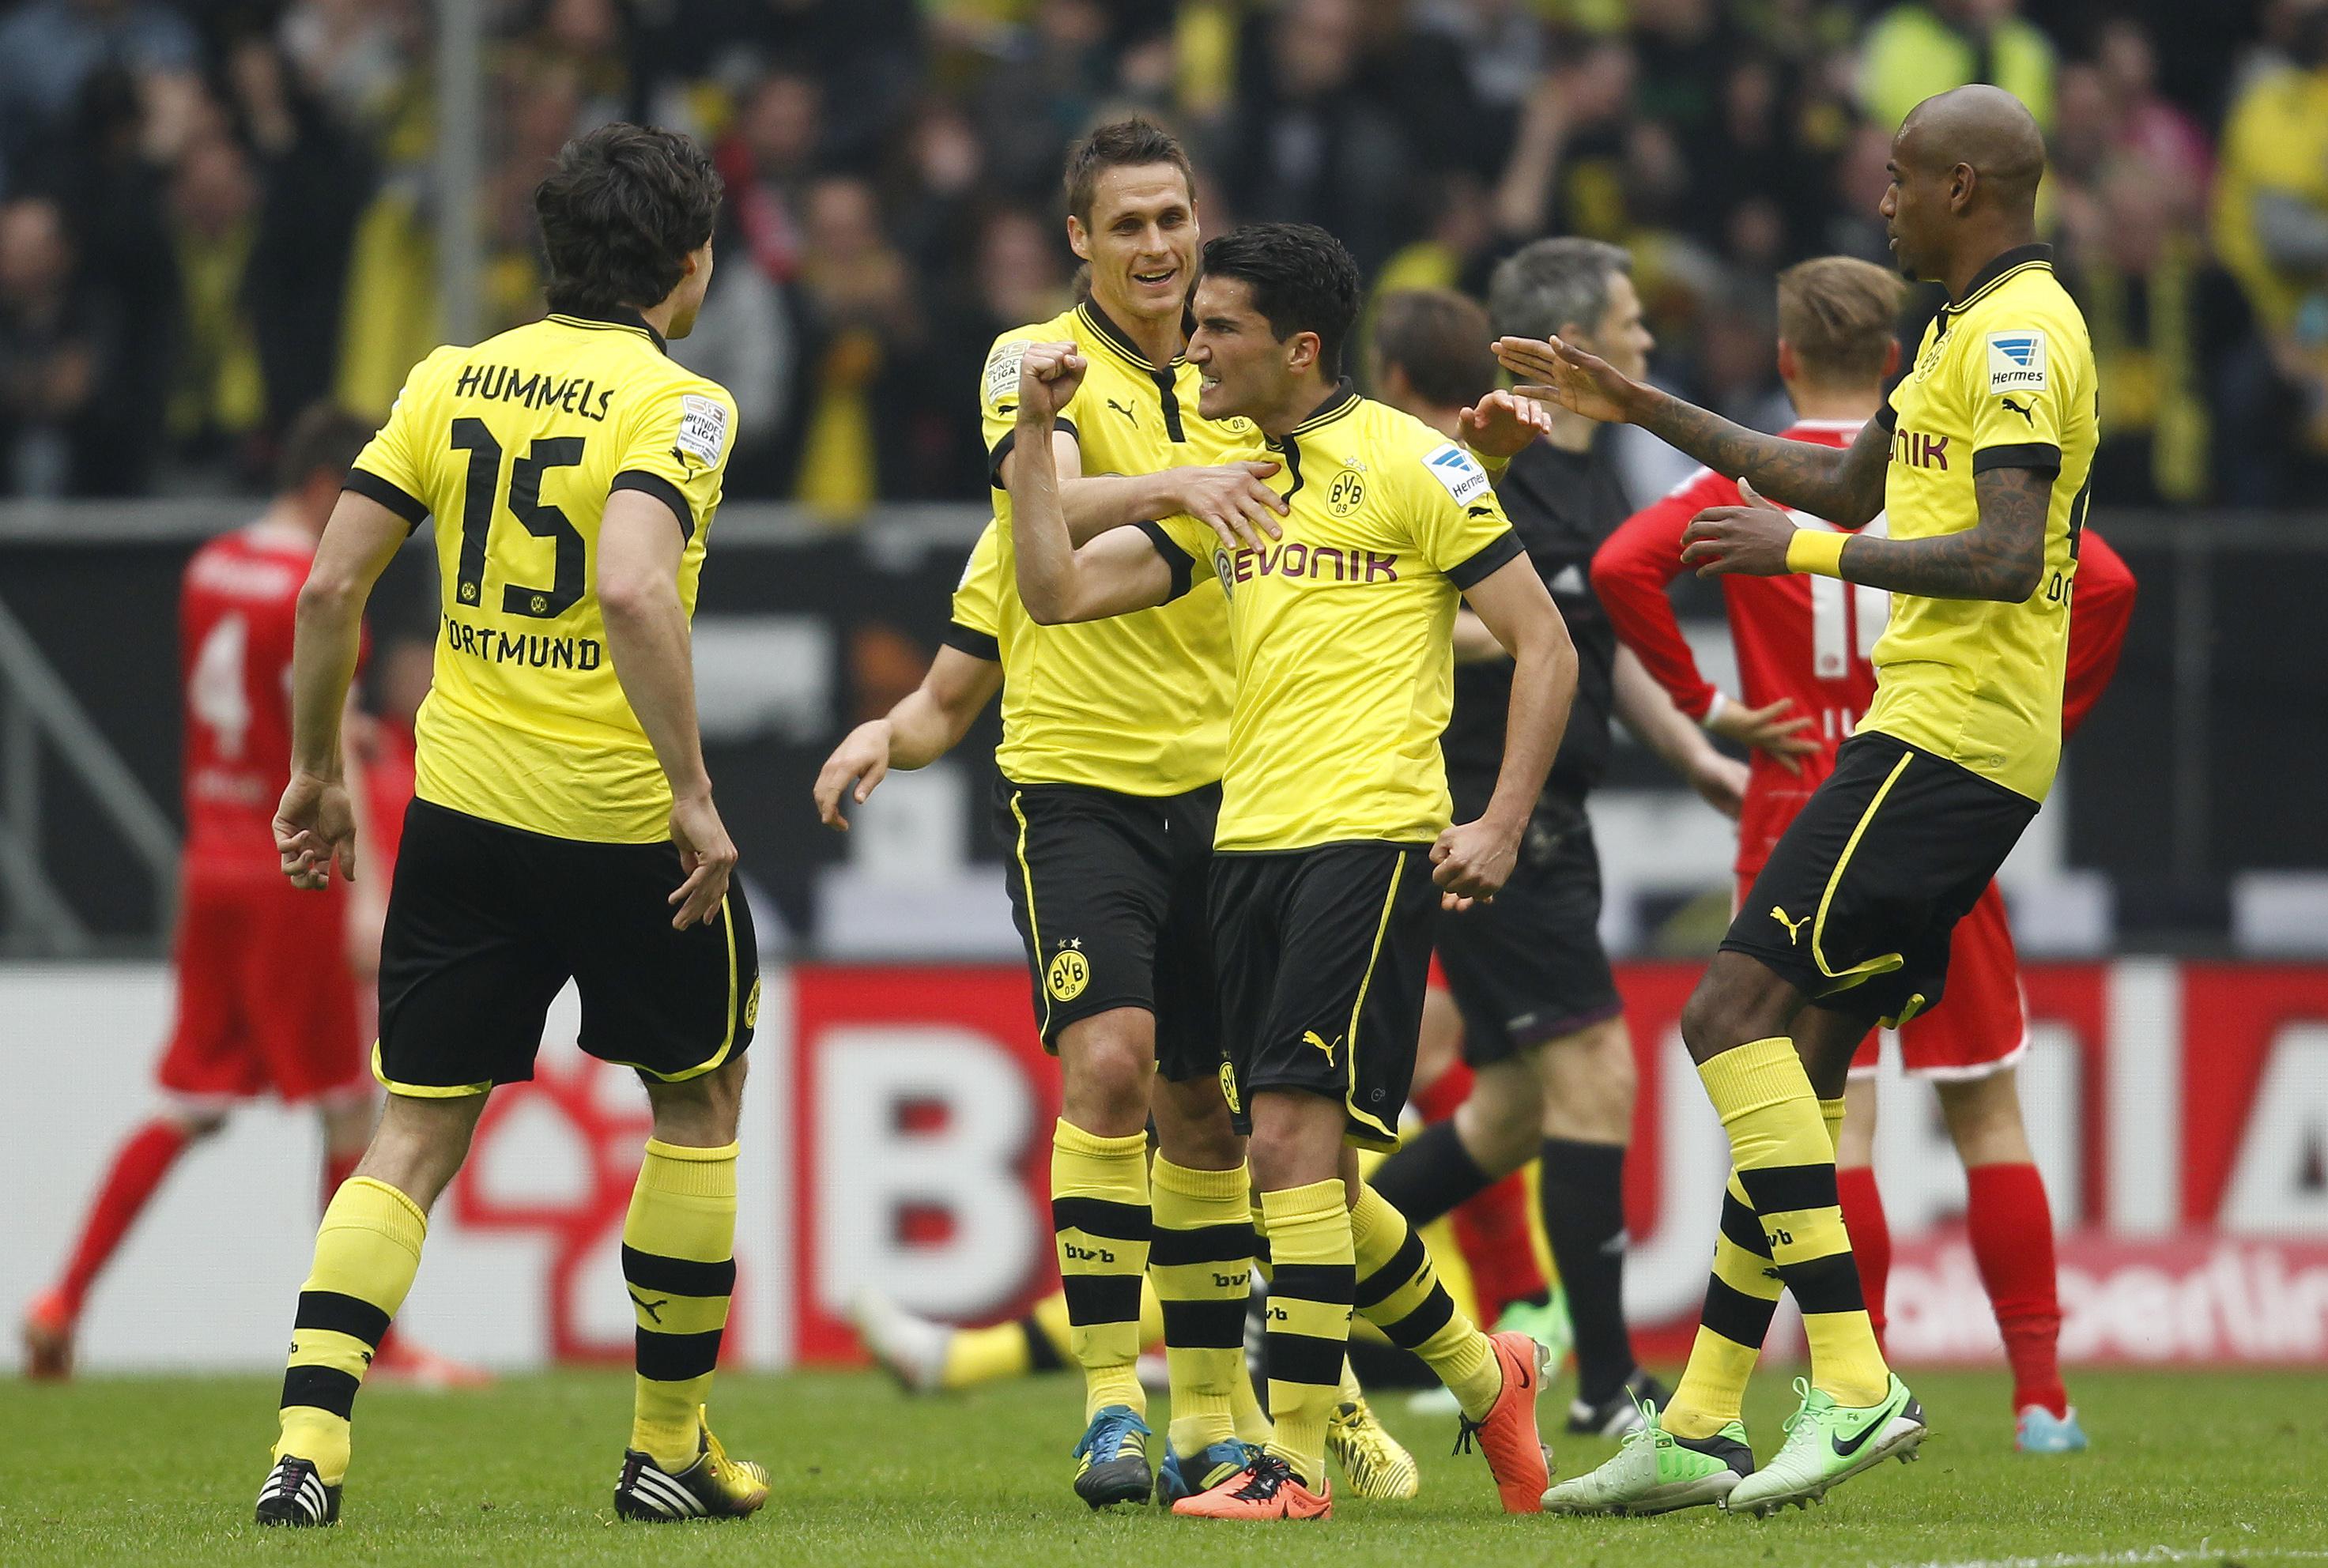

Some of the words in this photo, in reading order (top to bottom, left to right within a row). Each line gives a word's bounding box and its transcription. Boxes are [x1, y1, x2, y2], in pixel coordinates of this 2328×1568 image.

[988, 359, 1022, 379] BUNDE
[993, 367, 1016, 383] LIGA
[1991, 371, 2043, 385] Hermes
[455, 364, 615, 422] HUMMELS
[685, 413, 723, 440] BUNDES
[692, 425, 715, 445] LIGA
[1888, 428, 1949, 471] NIK
[1330, 474, 1362, 504] BVB
[1452, 473, 1485, 498] Hermes
[451, 416, 586, 619] 15
[1336, 503, 1347, 513] 09
[1235, 543, 1398, 583] EVONIK
[444, 612, 601, 670] ORTMUND
[1053, 955, 1084, 990] BVB
[1065, 983, 1076, 995] 09
[1065, 1242, 1115, 1263] bvb
